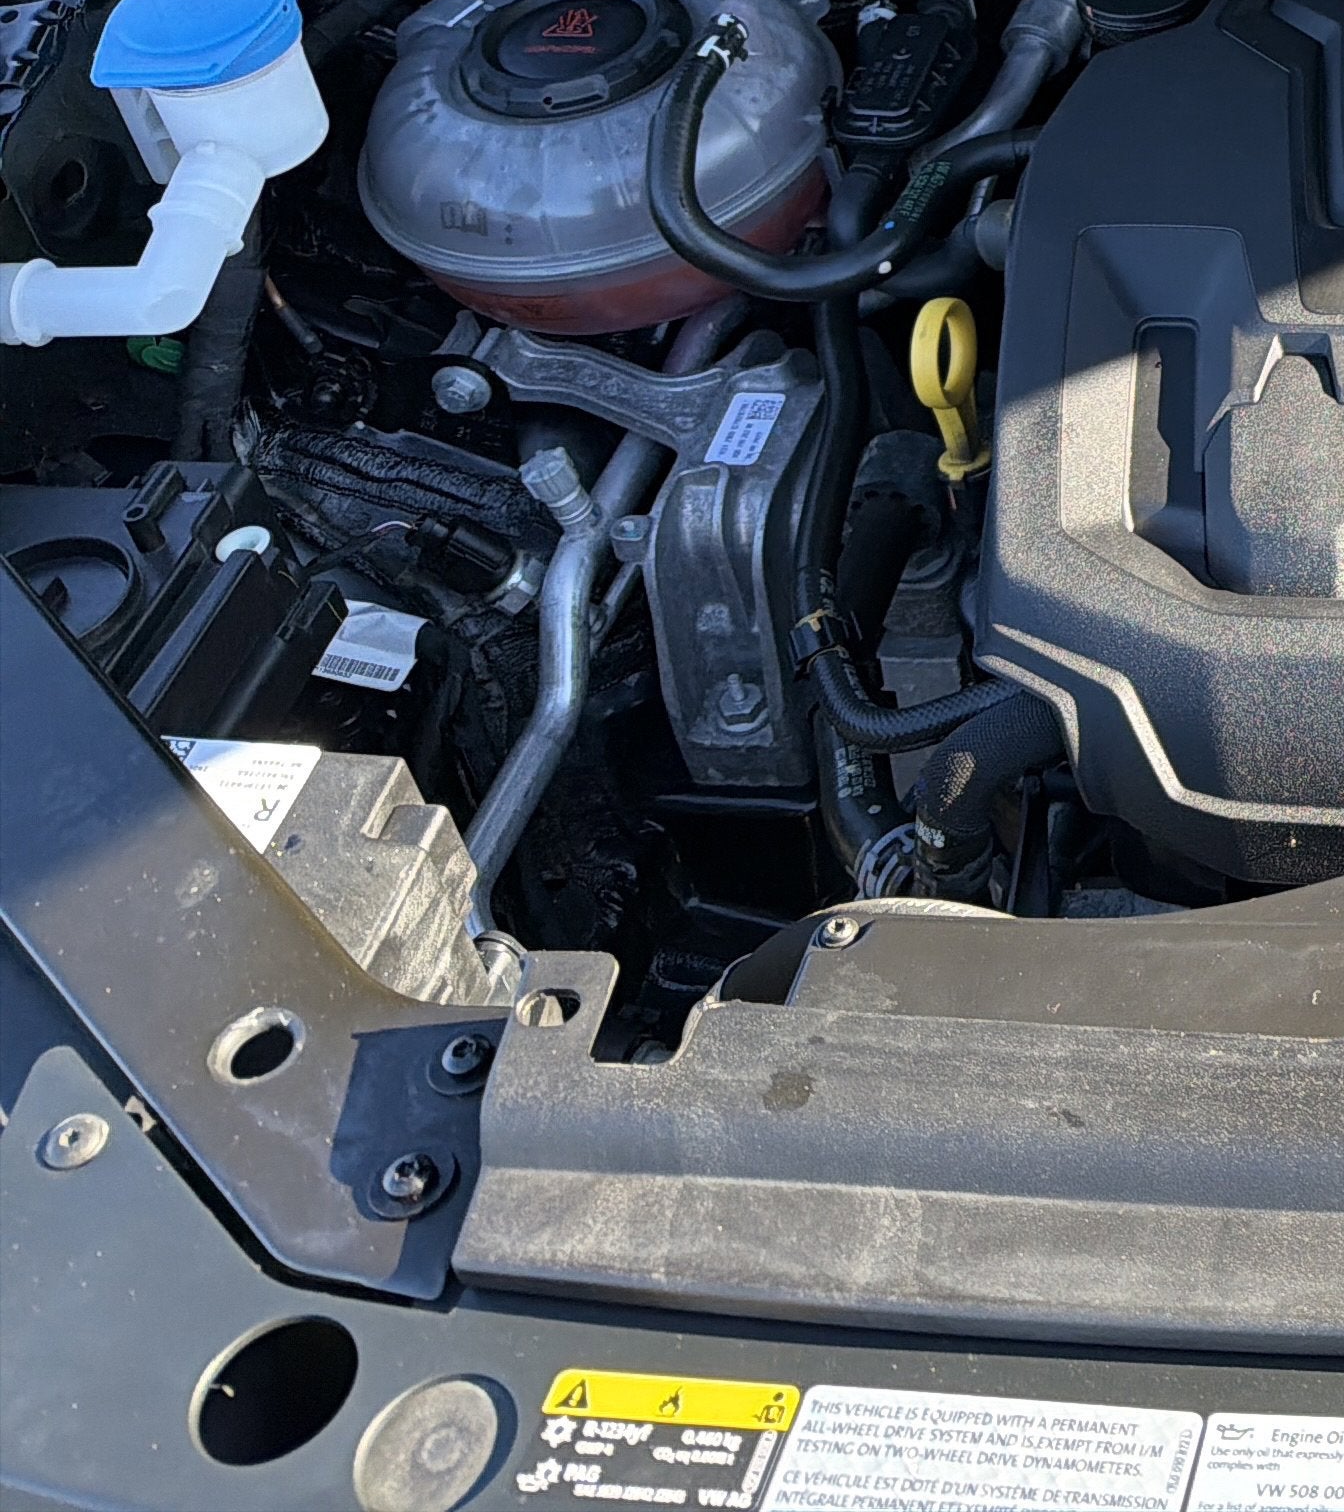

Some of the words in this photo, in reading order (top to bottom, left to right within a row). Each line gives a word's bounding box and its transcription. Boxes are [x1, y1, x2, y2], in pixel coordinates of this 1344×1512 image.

[253, 798, 281, 822] R
[810, 1399, 843, 1415] THIS
[844, 1402, 901, 1420] VEHICLE
[905, 1407, 918, 1421] IS
[921, 1407, 993, 1426] EQUIPPED
[997, 1414, 1034, 1429] WITH
[1038, 1416, 1048, 1430] A
[1051, 1418, 1140, 1437] PERMANENT
[801, 1418, 879, 1439] ALL-WHEEL
[883, 1425, 927, 1441] DRIVE
[930, 1428, 982, 1445] SYSTEM
[986, 1432, 1018, 1447] AND
[1021, 1434, 1034, 1448] IS
[1037, 1436, 1093, 1453] EXEMPT
[1095, 1441, 1137, 1456] FROM
[1139, 1445, 1164, 1459] I/M
[1271, 1429, 1323, 1447] Engine
[797, 1438, 855, 1456] TESTING
[857, 1442, 882, 1458] ON
[884, 1445, 973, 1465] TWO-WHEEL
[977, 1451, 1018, 1468] DRIVE
[1023, 1455, 1143, 1477] DYNAMOMETERS.
[1210, 1446, 1231, 1457] Use
[1232, 1447, 1256, 1459] only
[1257, 1447, 1271, 1457] oil
[1273, 1448, 1294, 1458] that
[1296, 1451, 1344, 1462] expressly
[562, 1463, 602, 1483] PAG
[1207, 1460, 1253, 1472] complies
[1257, 1461, 1281, 1471] with
[698, 1489, 729, 1507] VW
[725, 1491, 753, 1510] AG
[775, 1488, 850, 1507] INTÉGRALE
[783, 1469, 800, 1484] CE
[803, 1470, 871, 1489] VÉHICULE
[873, 1476, 898, 1490] EST
[900, 1476, 940, 1494] DOTÉ
[981, 1484, 1038, 1502] SYSTÈME
[1064, 1491, 1168, 1511] TRANSMISSION
[1256, 1483, 1286, 1498] VW
[1289, 1485, 1320, 1499] 508
